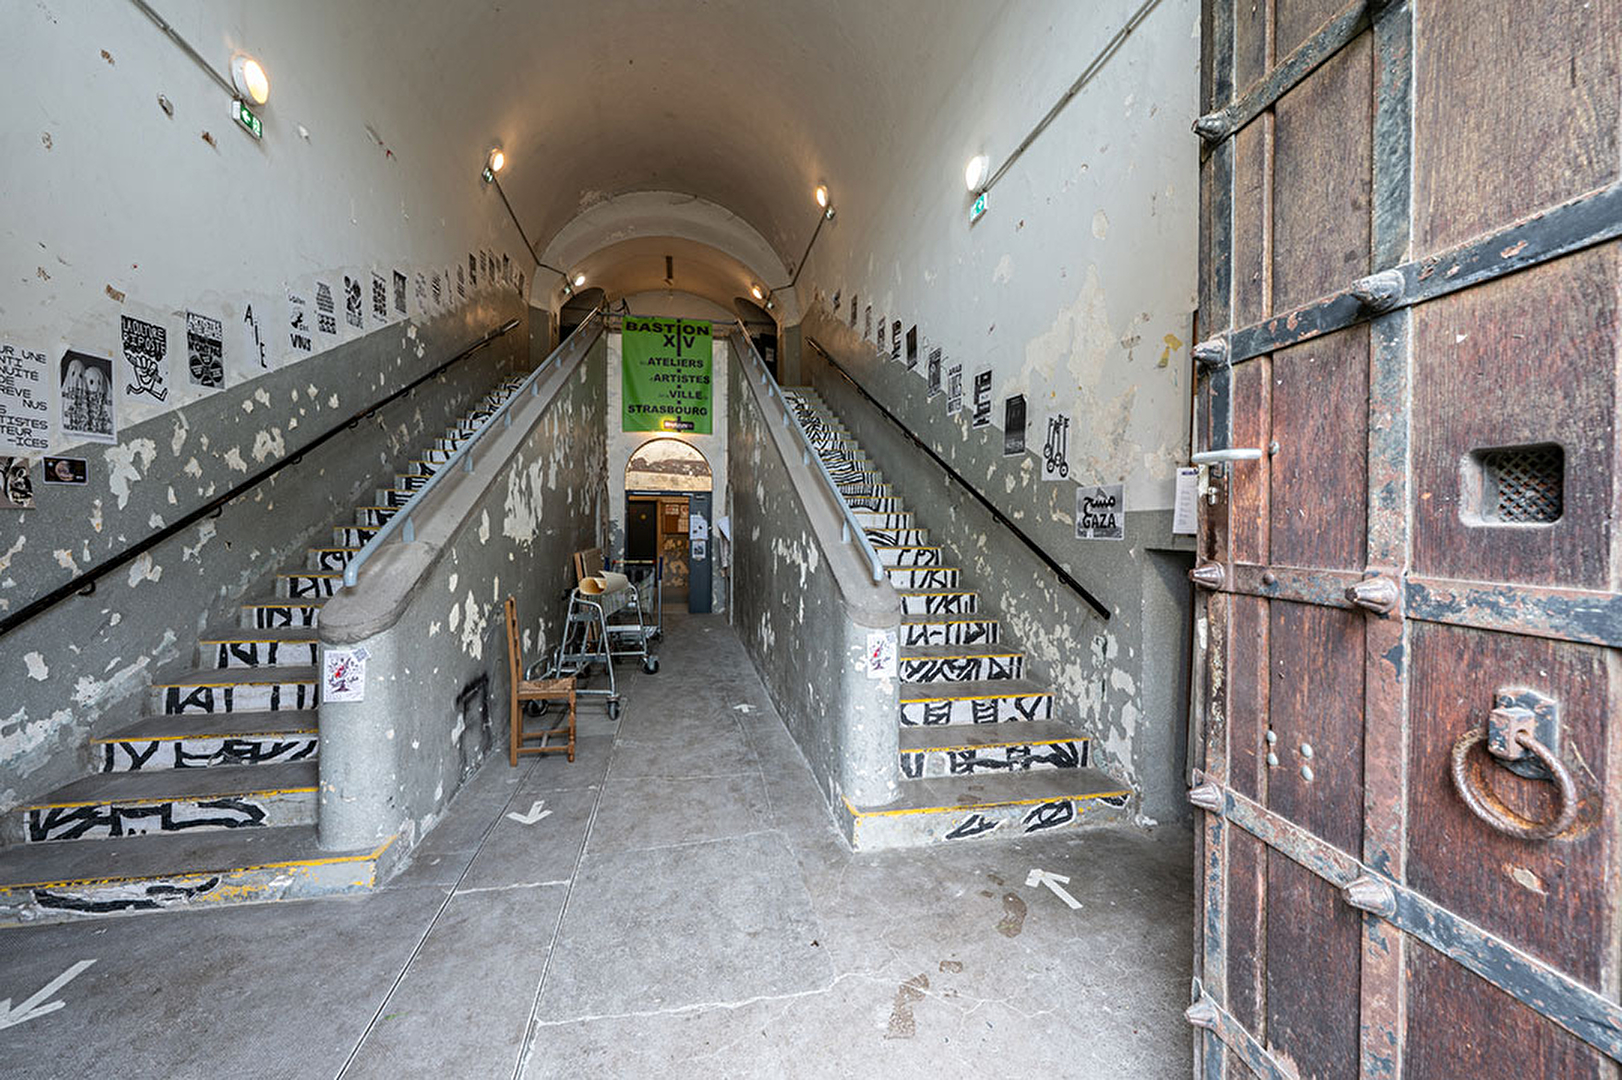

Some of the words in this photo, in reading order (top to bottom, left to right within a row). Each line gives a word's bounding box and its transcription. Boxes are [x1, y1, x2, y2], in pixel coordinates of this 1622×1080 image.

[626, 319, 709, 335] BASTION
[663, 334, 695, 357] XIV
[22, 349, 46, 365] UNE
[648, 357, 704, 368] ATELIERS
[669, 390, 703, 400] VILLE
[22, 398, 48, 411] NUS
[628, 404, 708, 416] STRASBOURG
[1082, 513, 1116, 529] GAZA
